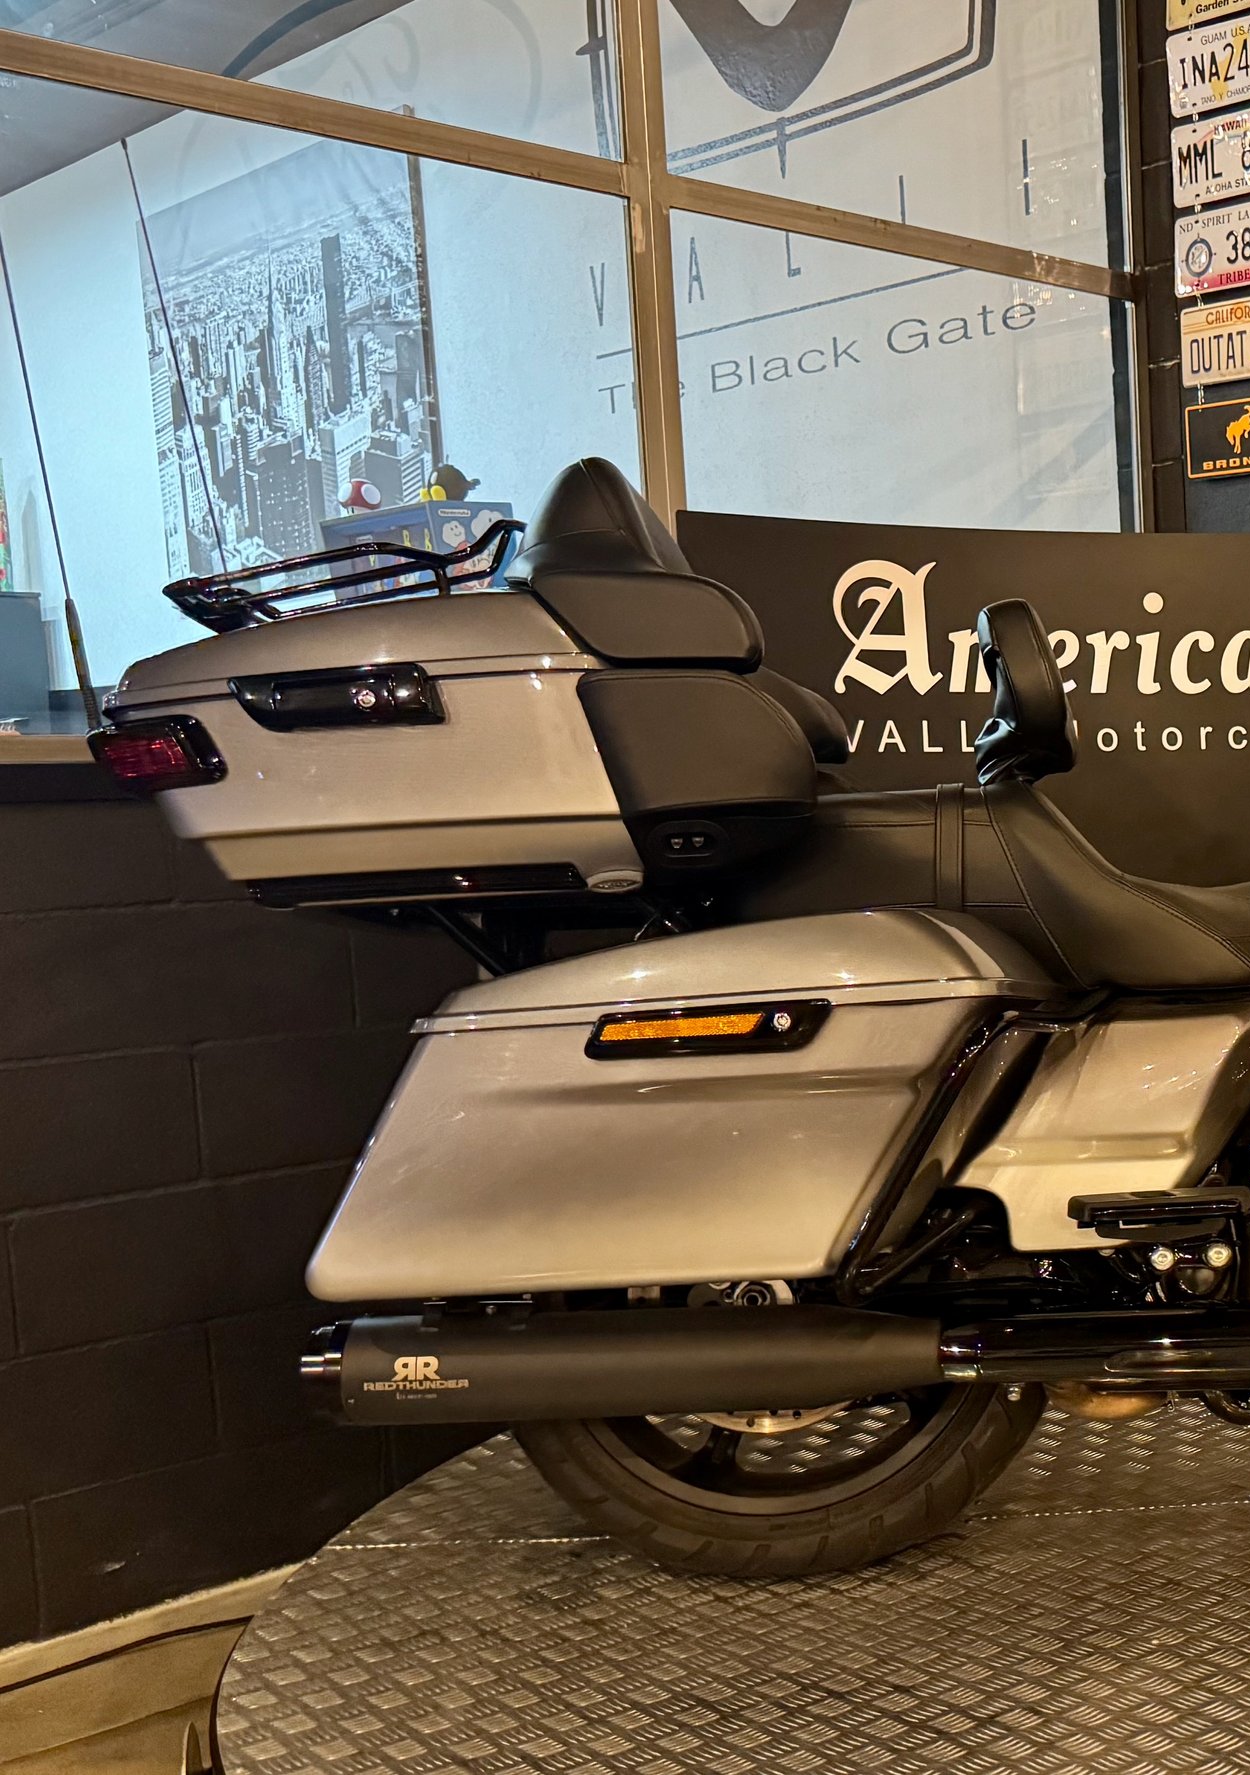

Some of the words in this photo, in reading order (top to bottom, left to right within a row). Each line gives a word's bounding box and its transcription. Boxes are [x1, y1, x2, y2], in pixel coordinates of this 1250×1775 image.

[1200, 31, 1227, 46] GUAM
[1178, 139, 1222, 188] MML
[1179, 222, 1194, 235] ND
[1201, 212, 1233, 229] SPIRIT
[710, 336, 860, 394] Black
[886, 300, 1037, 355] Gate
[363, 1379, 470, 1391] REDTHUNDER
